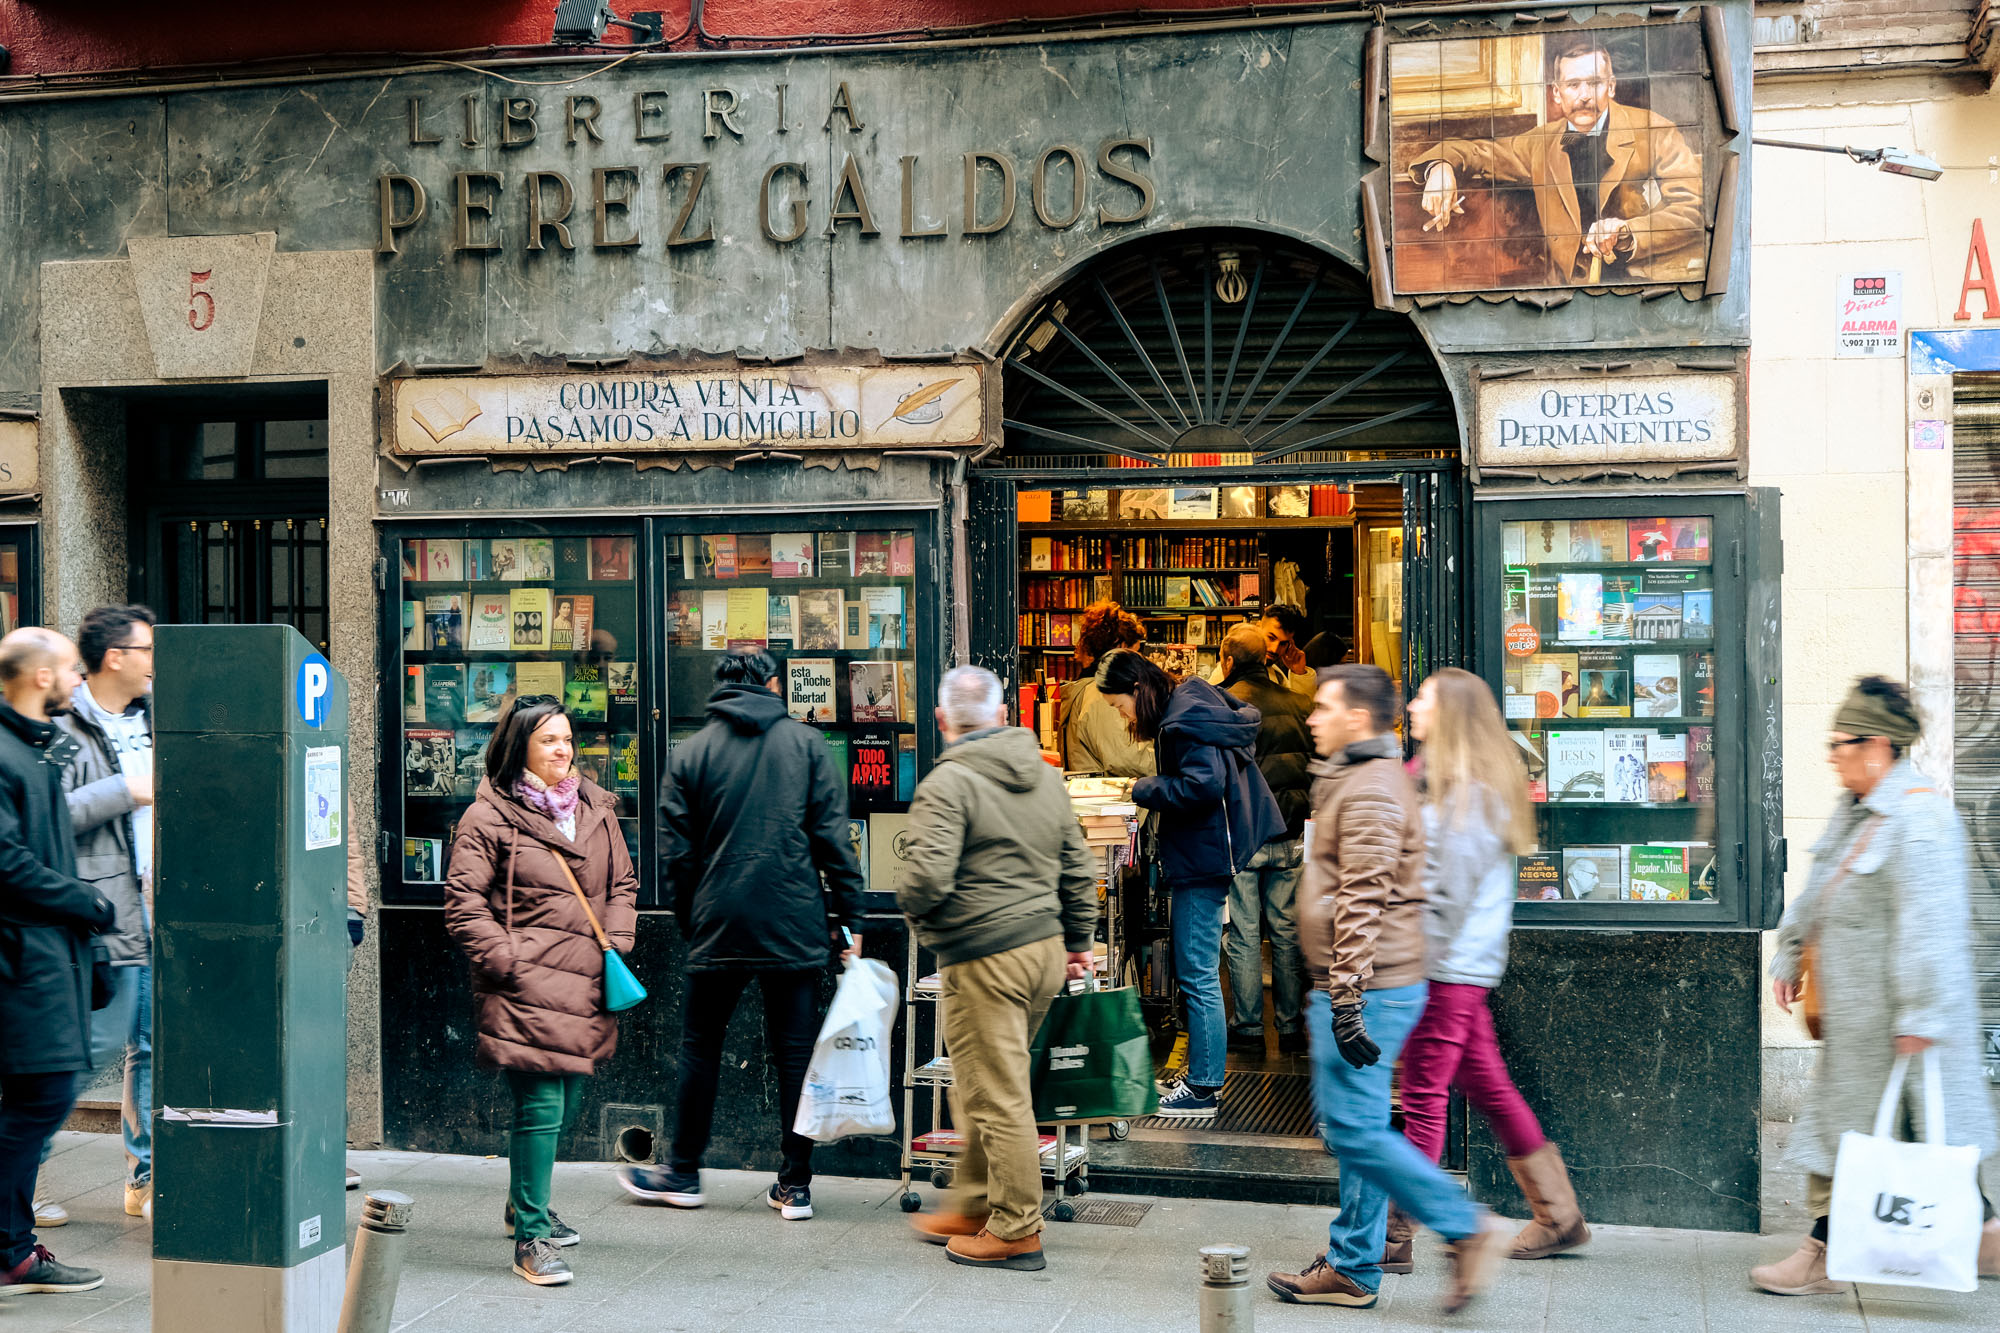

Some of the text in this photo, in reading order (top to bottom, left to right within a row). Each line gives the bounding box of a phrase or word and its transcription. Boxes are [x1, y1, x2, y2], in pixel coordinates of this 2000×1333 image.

[407, 80, 867, 149] LIBRERIA
[376, 136, 1156, 254] PEREZ GALDOS
[187, 268, 216, 332] 5
[1843, 294, 1895, 316] Direct
[1841, 319, 1897, 332] ALARMA
[1848, 339, 1898, 347] 902 121 122
[559, 377, 804, 414] COMPRA VENTA
[1540, 389, 1675, 419] OFERTAS
[505, 408, 860, 444] PASAMOS A DOMICILIO
[1498, 418, 1712, 450] PERMANENTES
[1508, 641, 1526, 651] yelp
[790, 666, 811, 678] esta
[304, 663, 327, 721] P
[793, 681, 802, 692] la
[791, 691, 827, 704] libertad
[852, 738, 890, 746] GÓMEZ-JURADO
[857, 749, 886, 764] TODO
[1560, 747, 1596, 761] JESÚS
[852, 764, 891, 785] ARDE
[1634, 861, 1660, 876] Jugador
[1664, 860, 1682, 873] Mus
